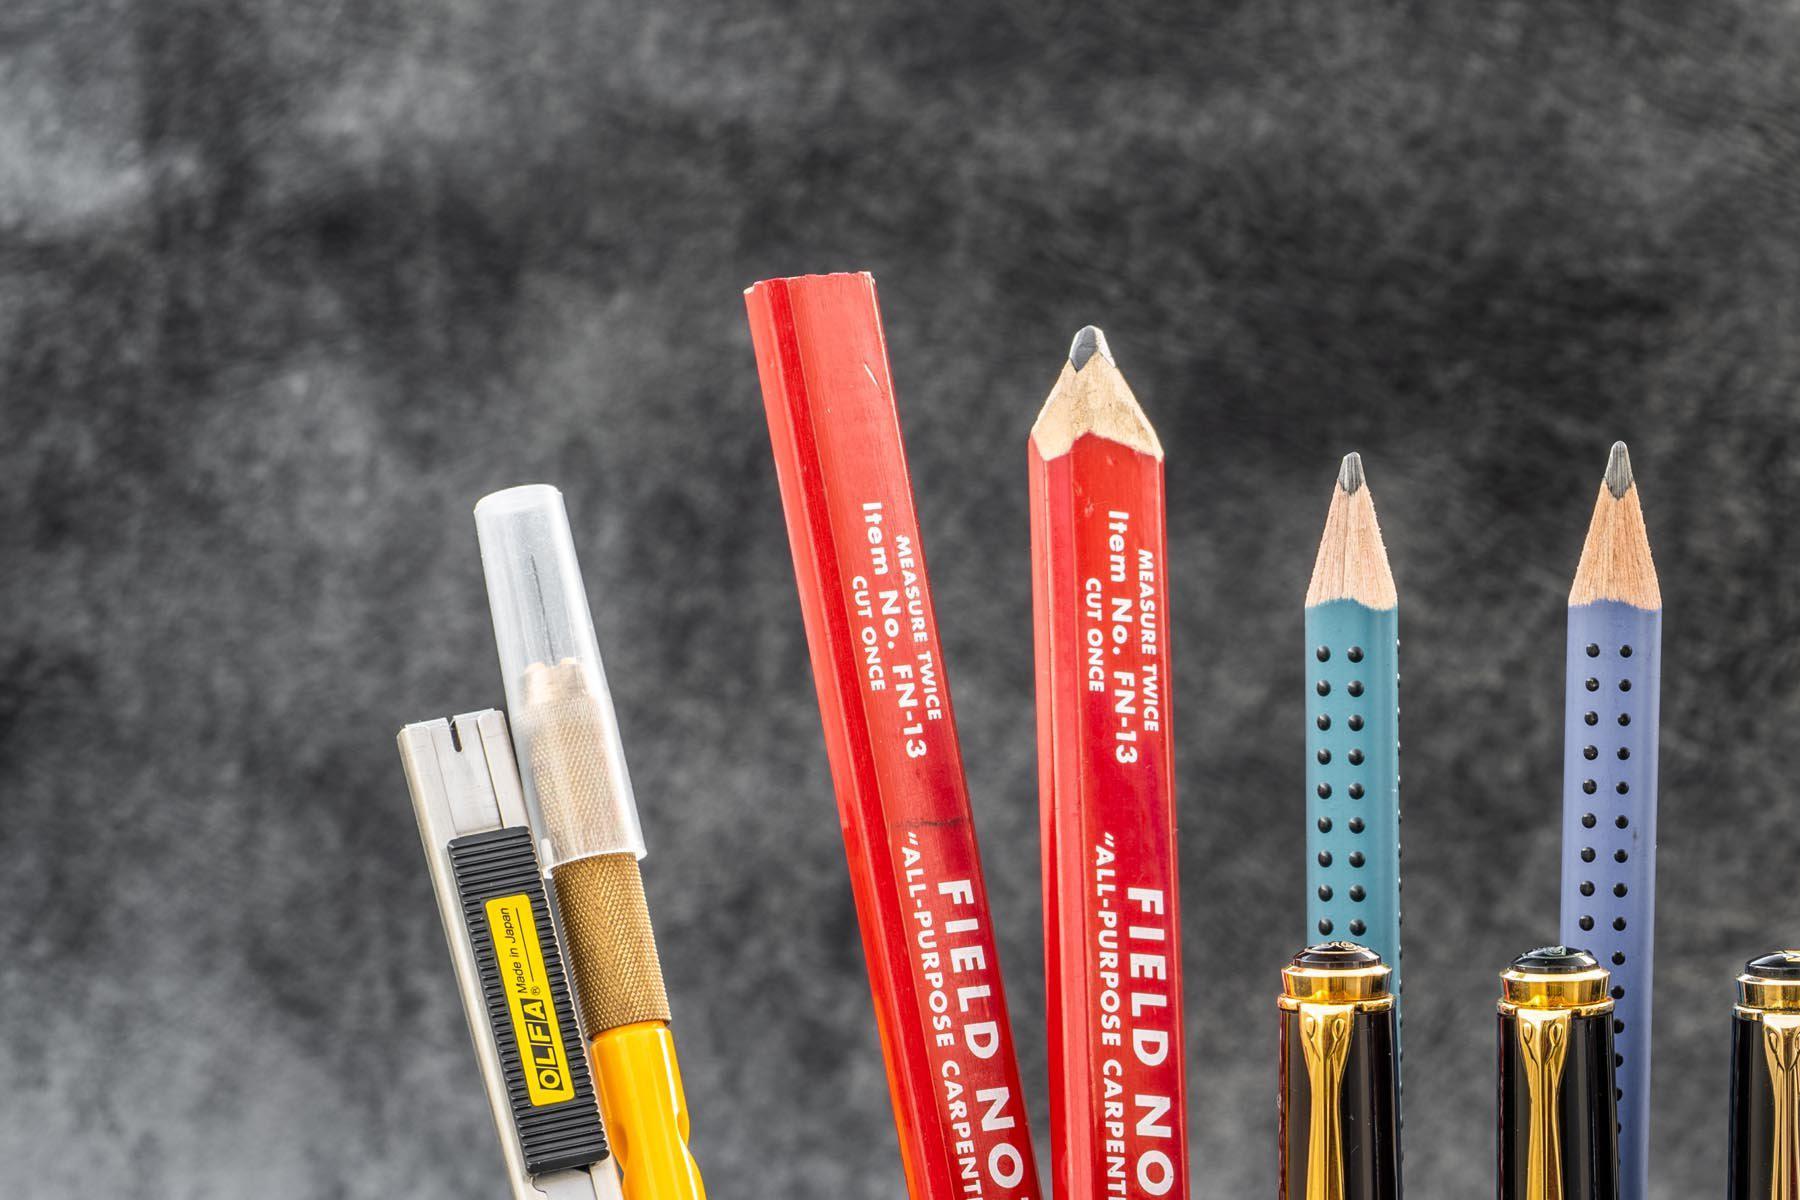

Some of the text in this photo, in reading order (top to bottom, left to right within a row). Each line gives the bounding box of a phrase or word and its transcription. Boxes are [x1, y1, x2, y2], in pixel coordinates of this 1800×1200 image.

[851, 575, 886, 692] CUT ONCE
[862, 501, 927, 759] Item No. FN-13
[895, 534, 943, 721] MEASURE TWICE
[1085, 577, 1105, 693] CUT ONCE
[1108, 509, 1138, 764] Item No. FN-13
[1137, 548, 1160, 733] MEASURE TWICE
[500, 907, 528, 994] Made in Japan
[937, 879, 999, 1060] FIELD
[1127, 886, 1169, 1067] FIELD
[522, 999, 563, 1091] OLFA
